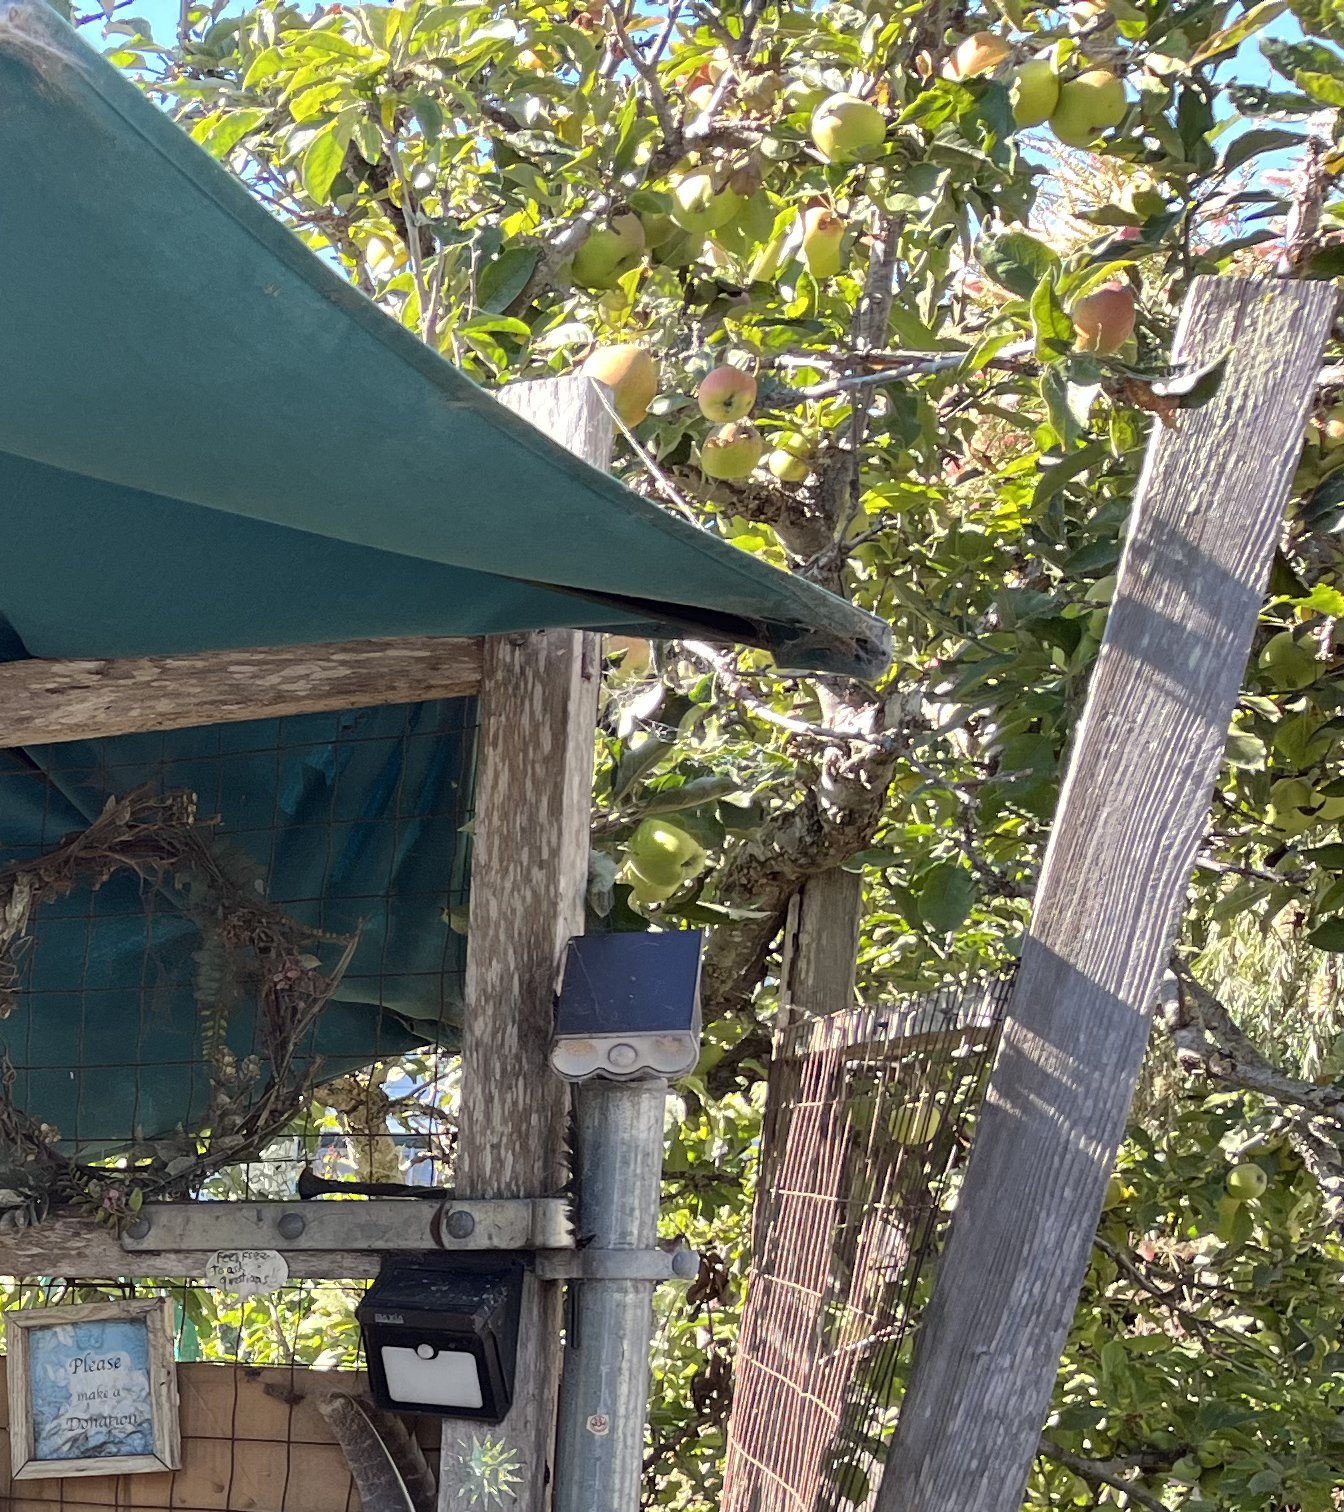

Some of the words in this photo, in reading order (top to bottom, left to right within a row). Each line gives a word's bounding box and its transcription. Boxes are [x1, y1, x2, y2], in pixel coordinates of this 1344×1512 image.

[216, 1251, 239, 1264] Feel
[69, 1351, 122, 1375] Please
[76, 1384, 109, 1401] make
[112, 1388, 121, 1397] a
[65, 1413, 138, 1432] Donation
